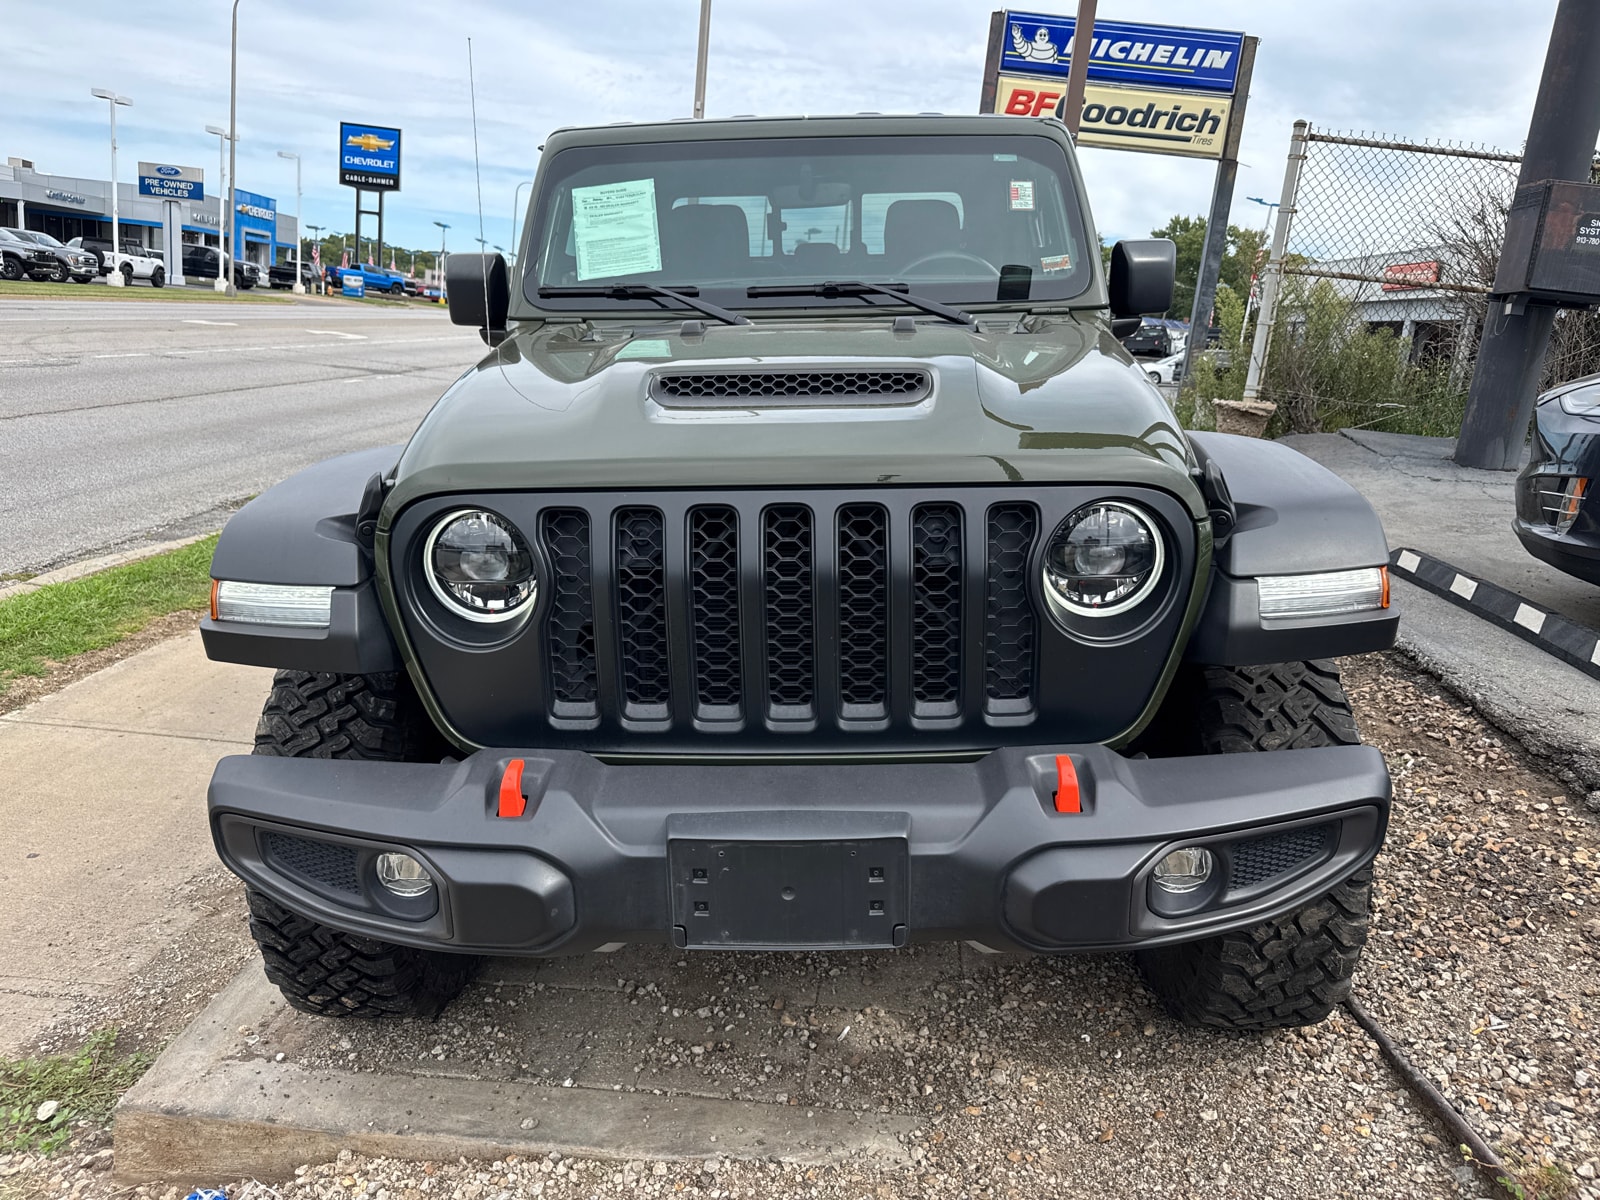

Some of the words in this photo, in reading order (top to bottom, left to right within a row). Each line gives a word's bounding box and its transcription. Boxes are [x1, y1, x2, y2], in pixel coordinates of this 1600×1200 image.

[1192, 135, 1213, 146] Tires
[344, 155, 395, 169] CHEVROLET
[160, 167, 176, 175] Ford
[345, 174, 394, 186] CABLE-DAHMER
[150, 187, 189, 198] VEHICLES
